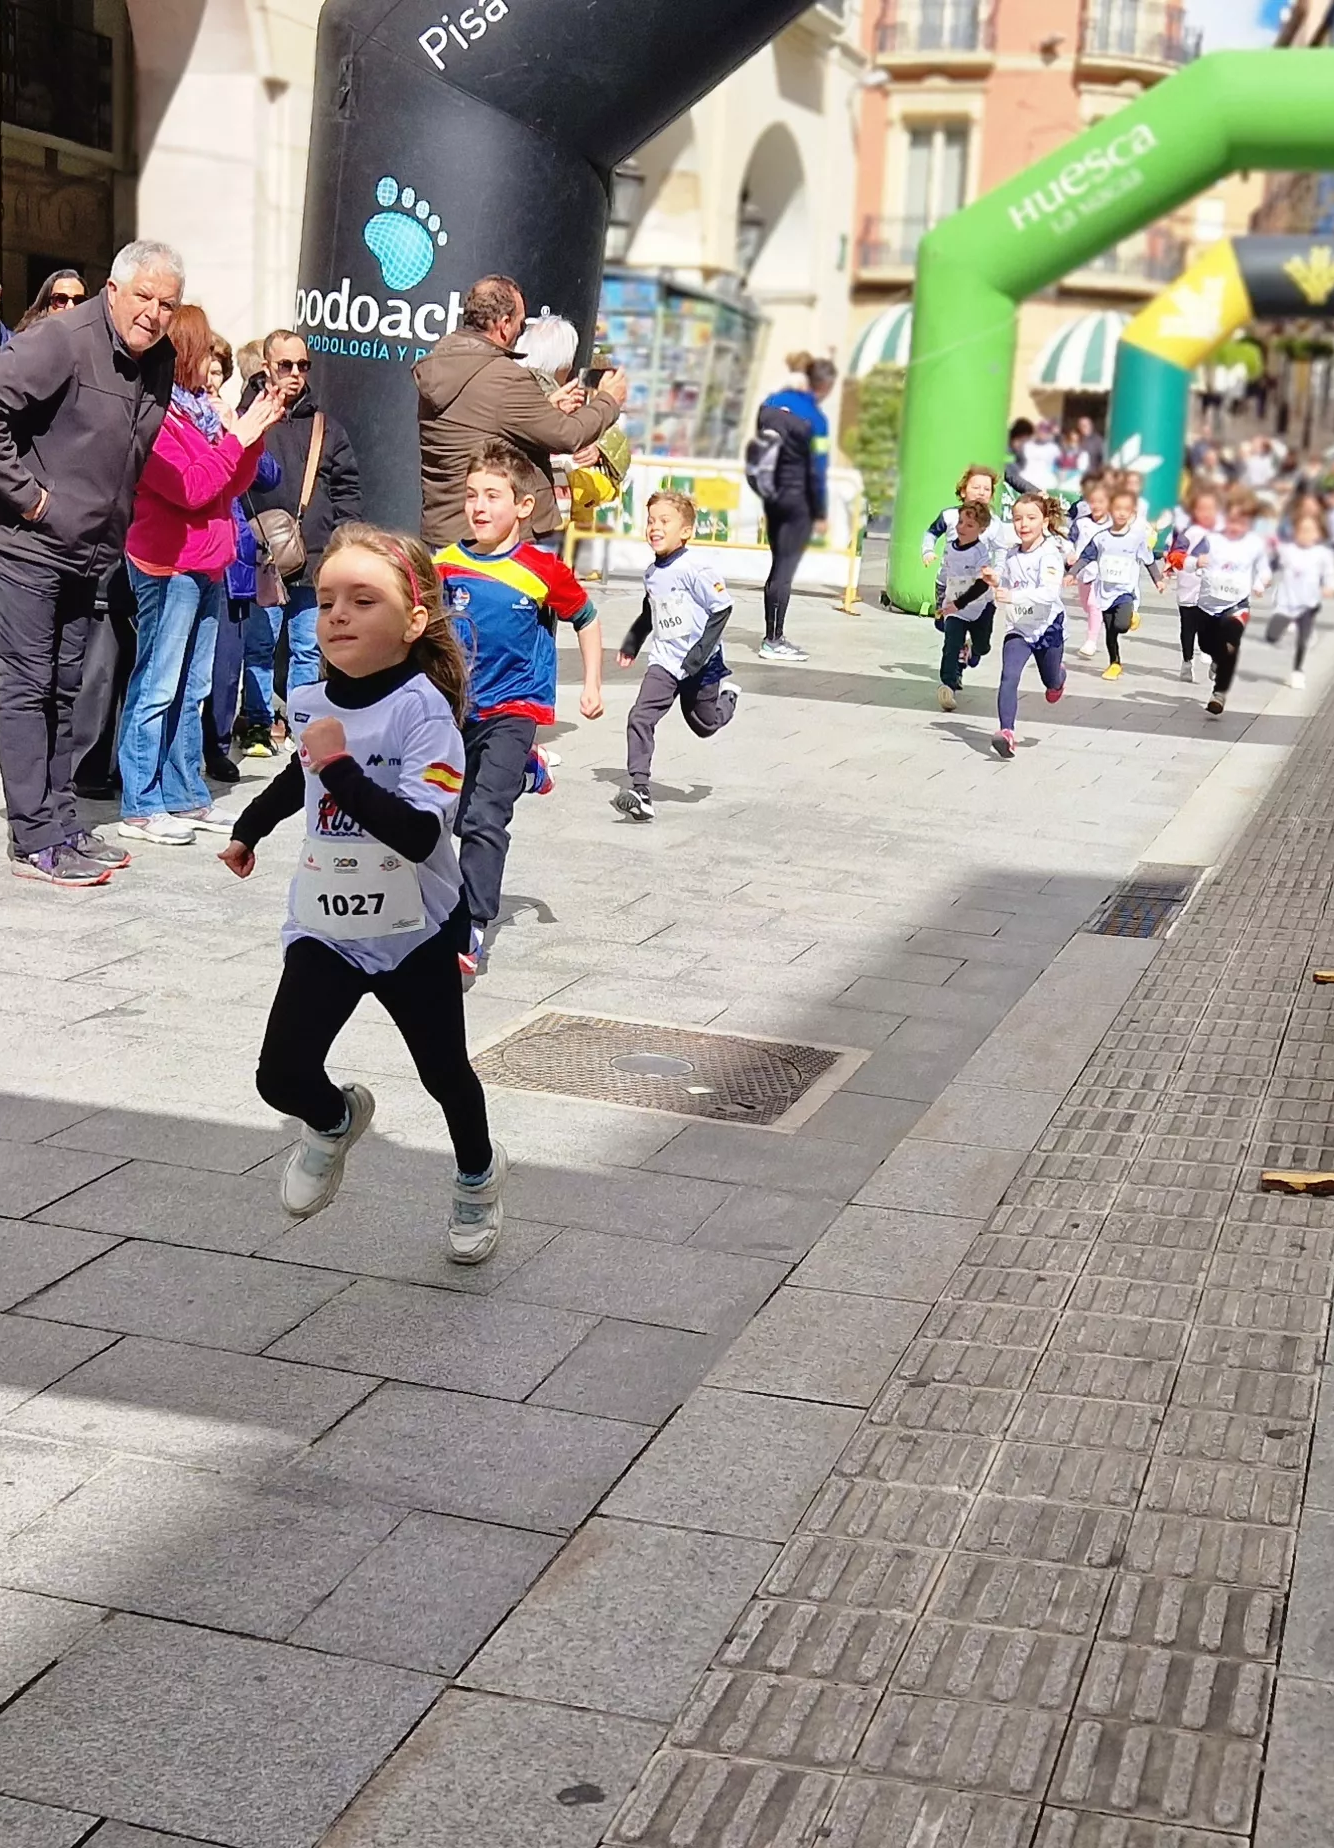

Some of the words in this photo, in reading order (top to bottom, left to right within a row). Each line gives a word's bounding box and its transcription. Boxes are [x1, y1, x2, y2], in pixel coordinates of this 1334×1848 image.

[306, 334, 391, 361] PODOLOGÍA
[397, 345, 409, 362] Y
[317, 892, 385, 917] 1027
